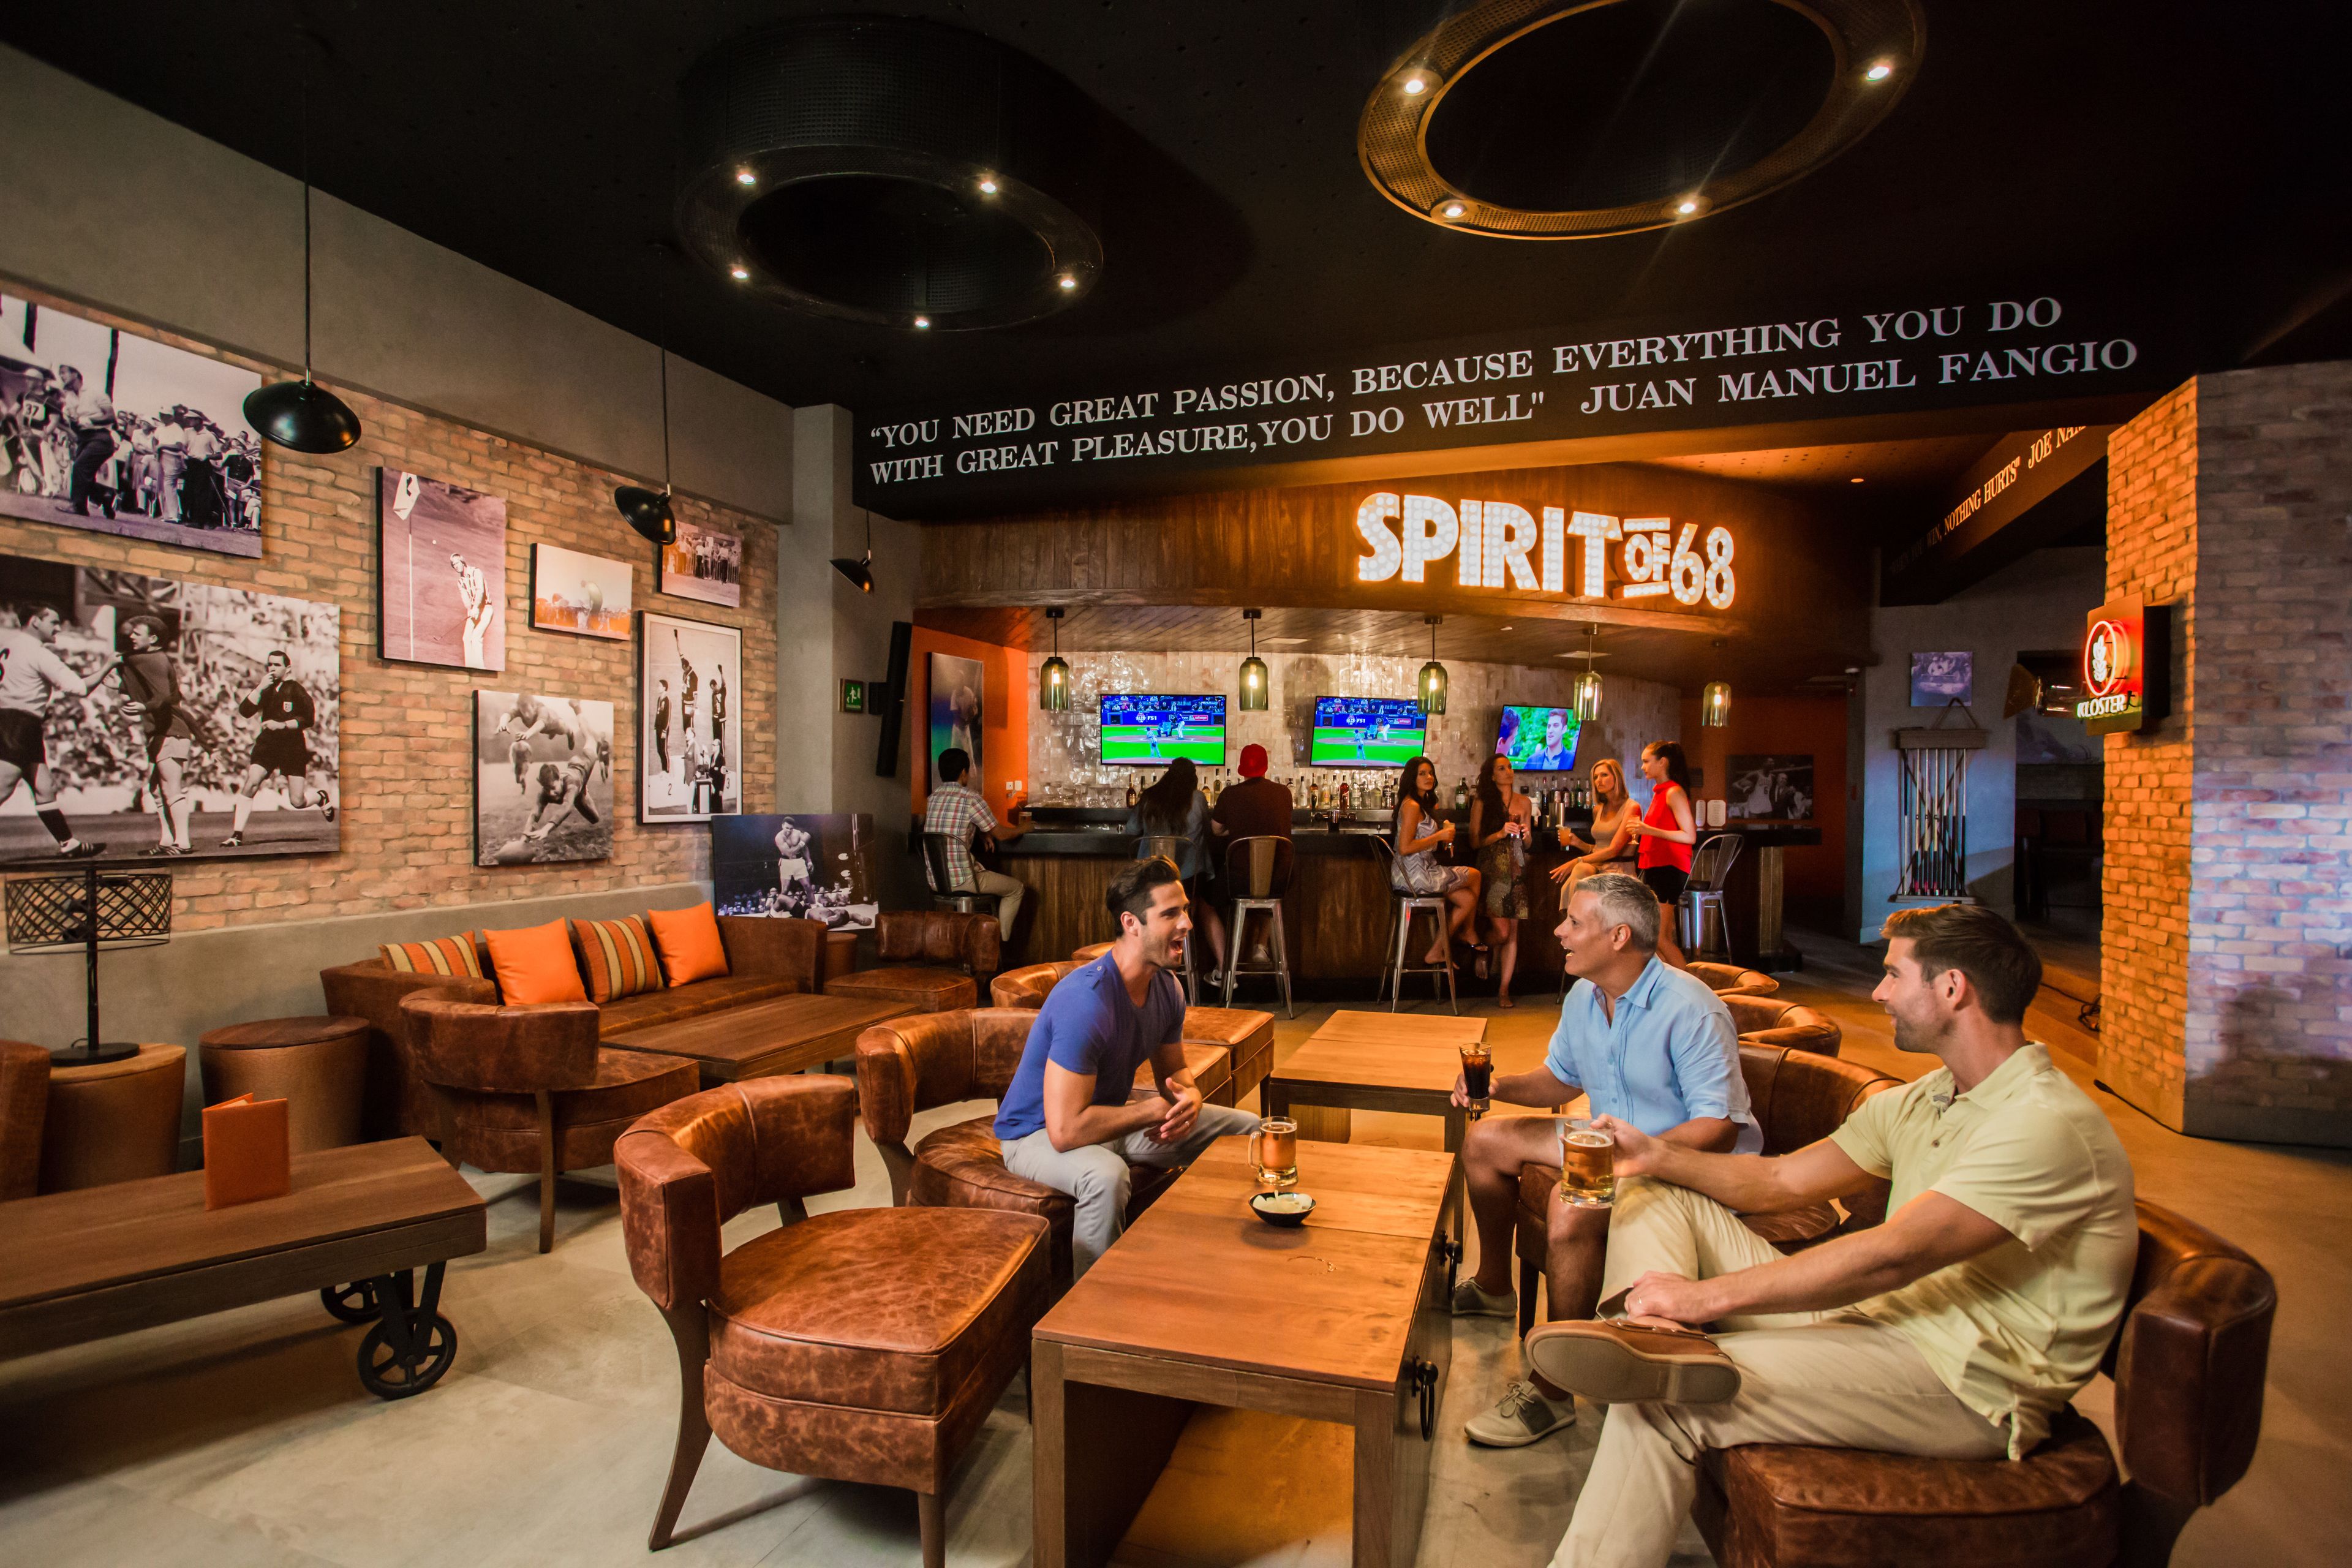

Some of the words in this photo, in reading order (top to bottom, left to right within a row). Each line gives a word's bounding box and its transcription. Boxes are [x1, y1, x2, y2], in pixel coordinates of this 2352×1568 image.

[870, 454, 944, 485] WITH
[956, 442, 1058, 473] GREAT
[1350, 407, 1404, 437] DO
[1581, 379, 1697, 415] JUAN
[1718, 358, 1916, 402] MANUEL
[1938, 338, 2137, 384] FANGIO
[952, 408, 1035, 439] NEED
[1049, 393, 1159, 426] GREAT
[1172, 373, 1335, 415] PASSION,
[1351, 350, 1532, 394] BECAUSE
[1552, 318, 1841, 373] EVERYTHING
[1863, 306, 1965, 342] YOU
[1988, 297, 2062, 331] DO
[1943, 488, 1981, 536] NOTHING
[2027, 431, 2052, 469] JOE
[1356, 491, 1623, 598] SPIRIT
[1624, 533, 1672, 583] OF
[1670, 522, 1735, 609] 68
[2077, 693, 2126, 718] KLOSTER
